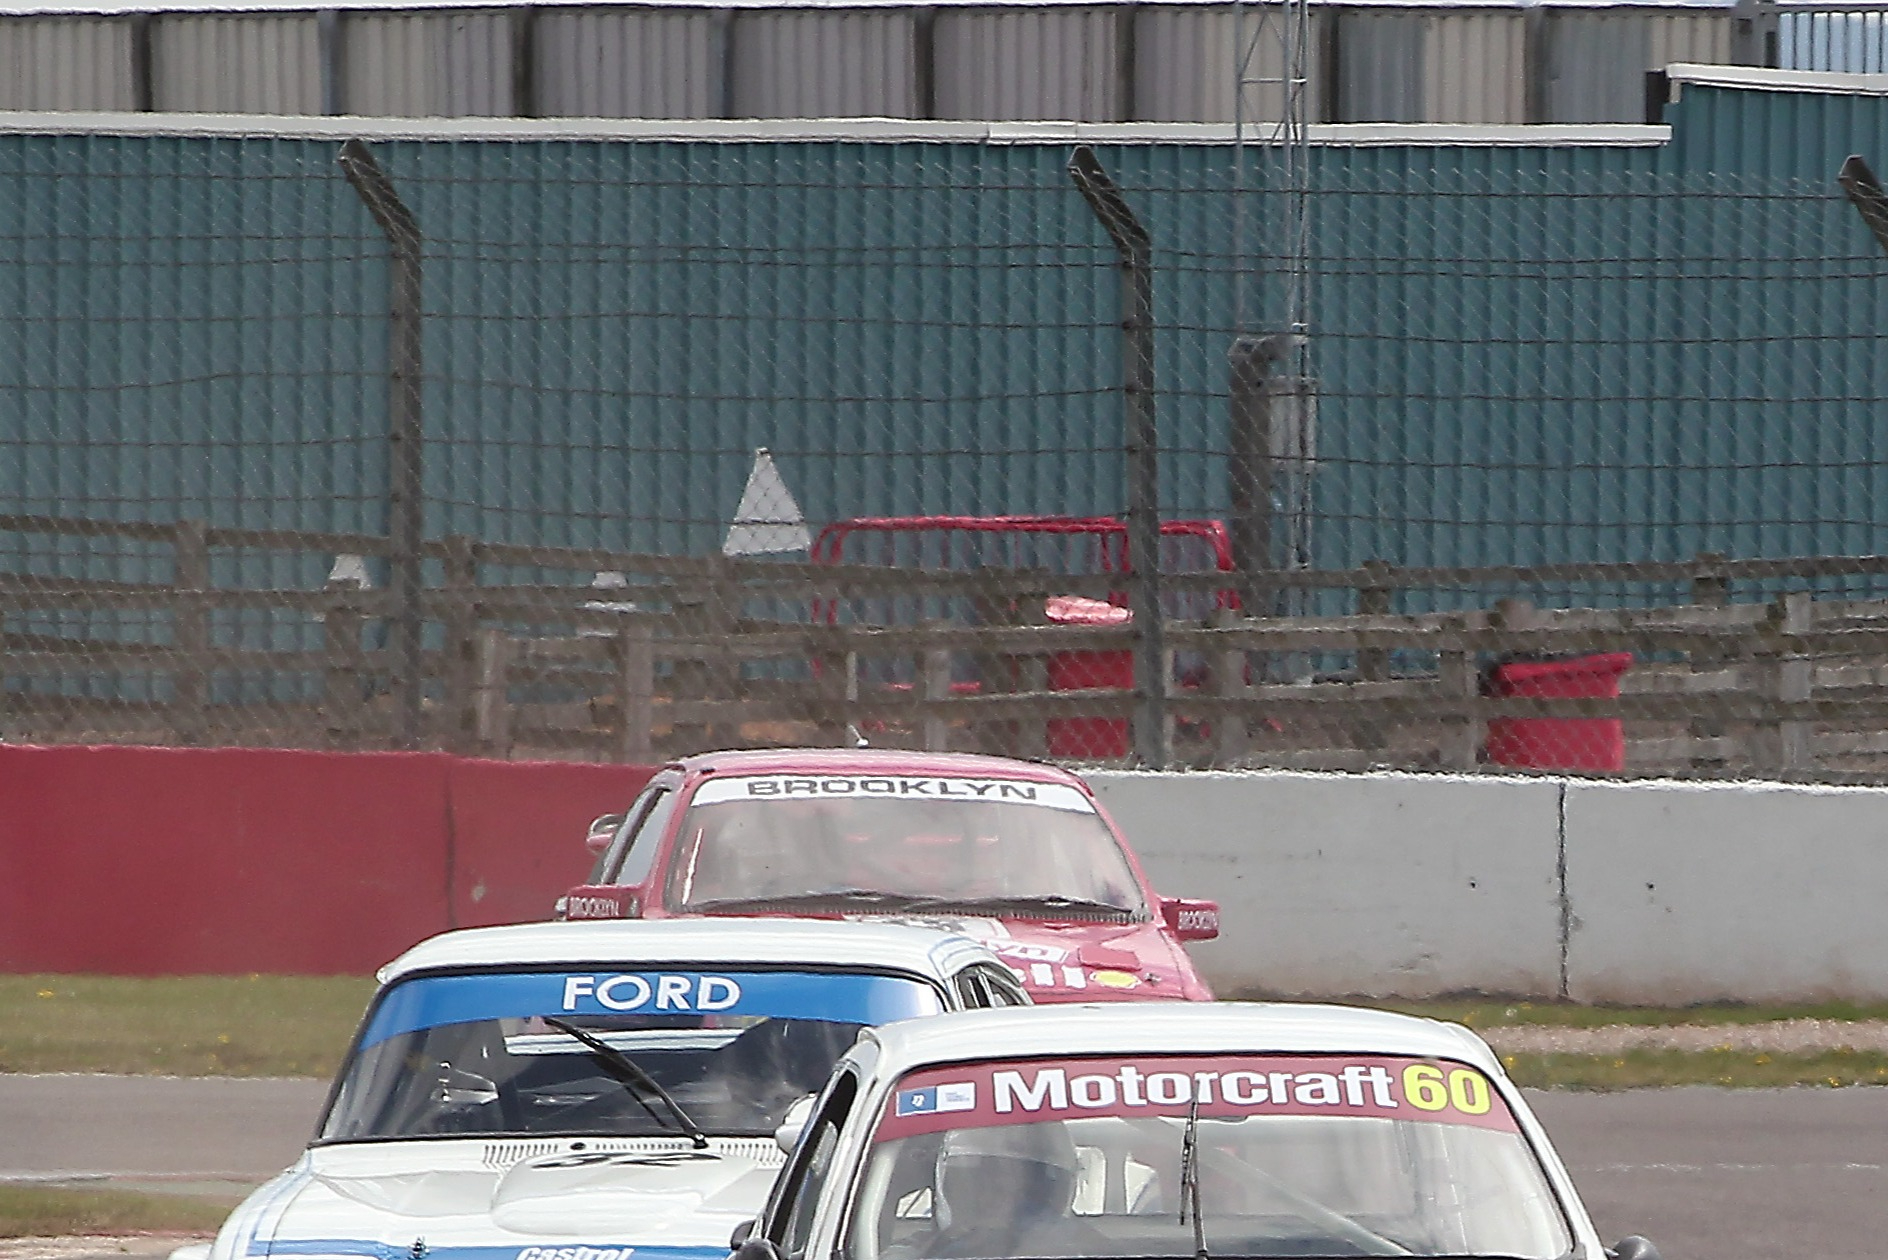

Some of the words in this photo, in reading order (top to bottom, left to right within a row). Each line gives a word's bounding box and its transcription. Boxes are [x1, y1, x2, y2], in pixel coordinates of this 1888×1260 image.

[747, 779, 1037, 800] BROOKLYN
[562, 975, 742, 1011] FORD
[993, 1065, 1399, 1113] Motorcraft
[1402, 1063, 1493, 1112] 60
